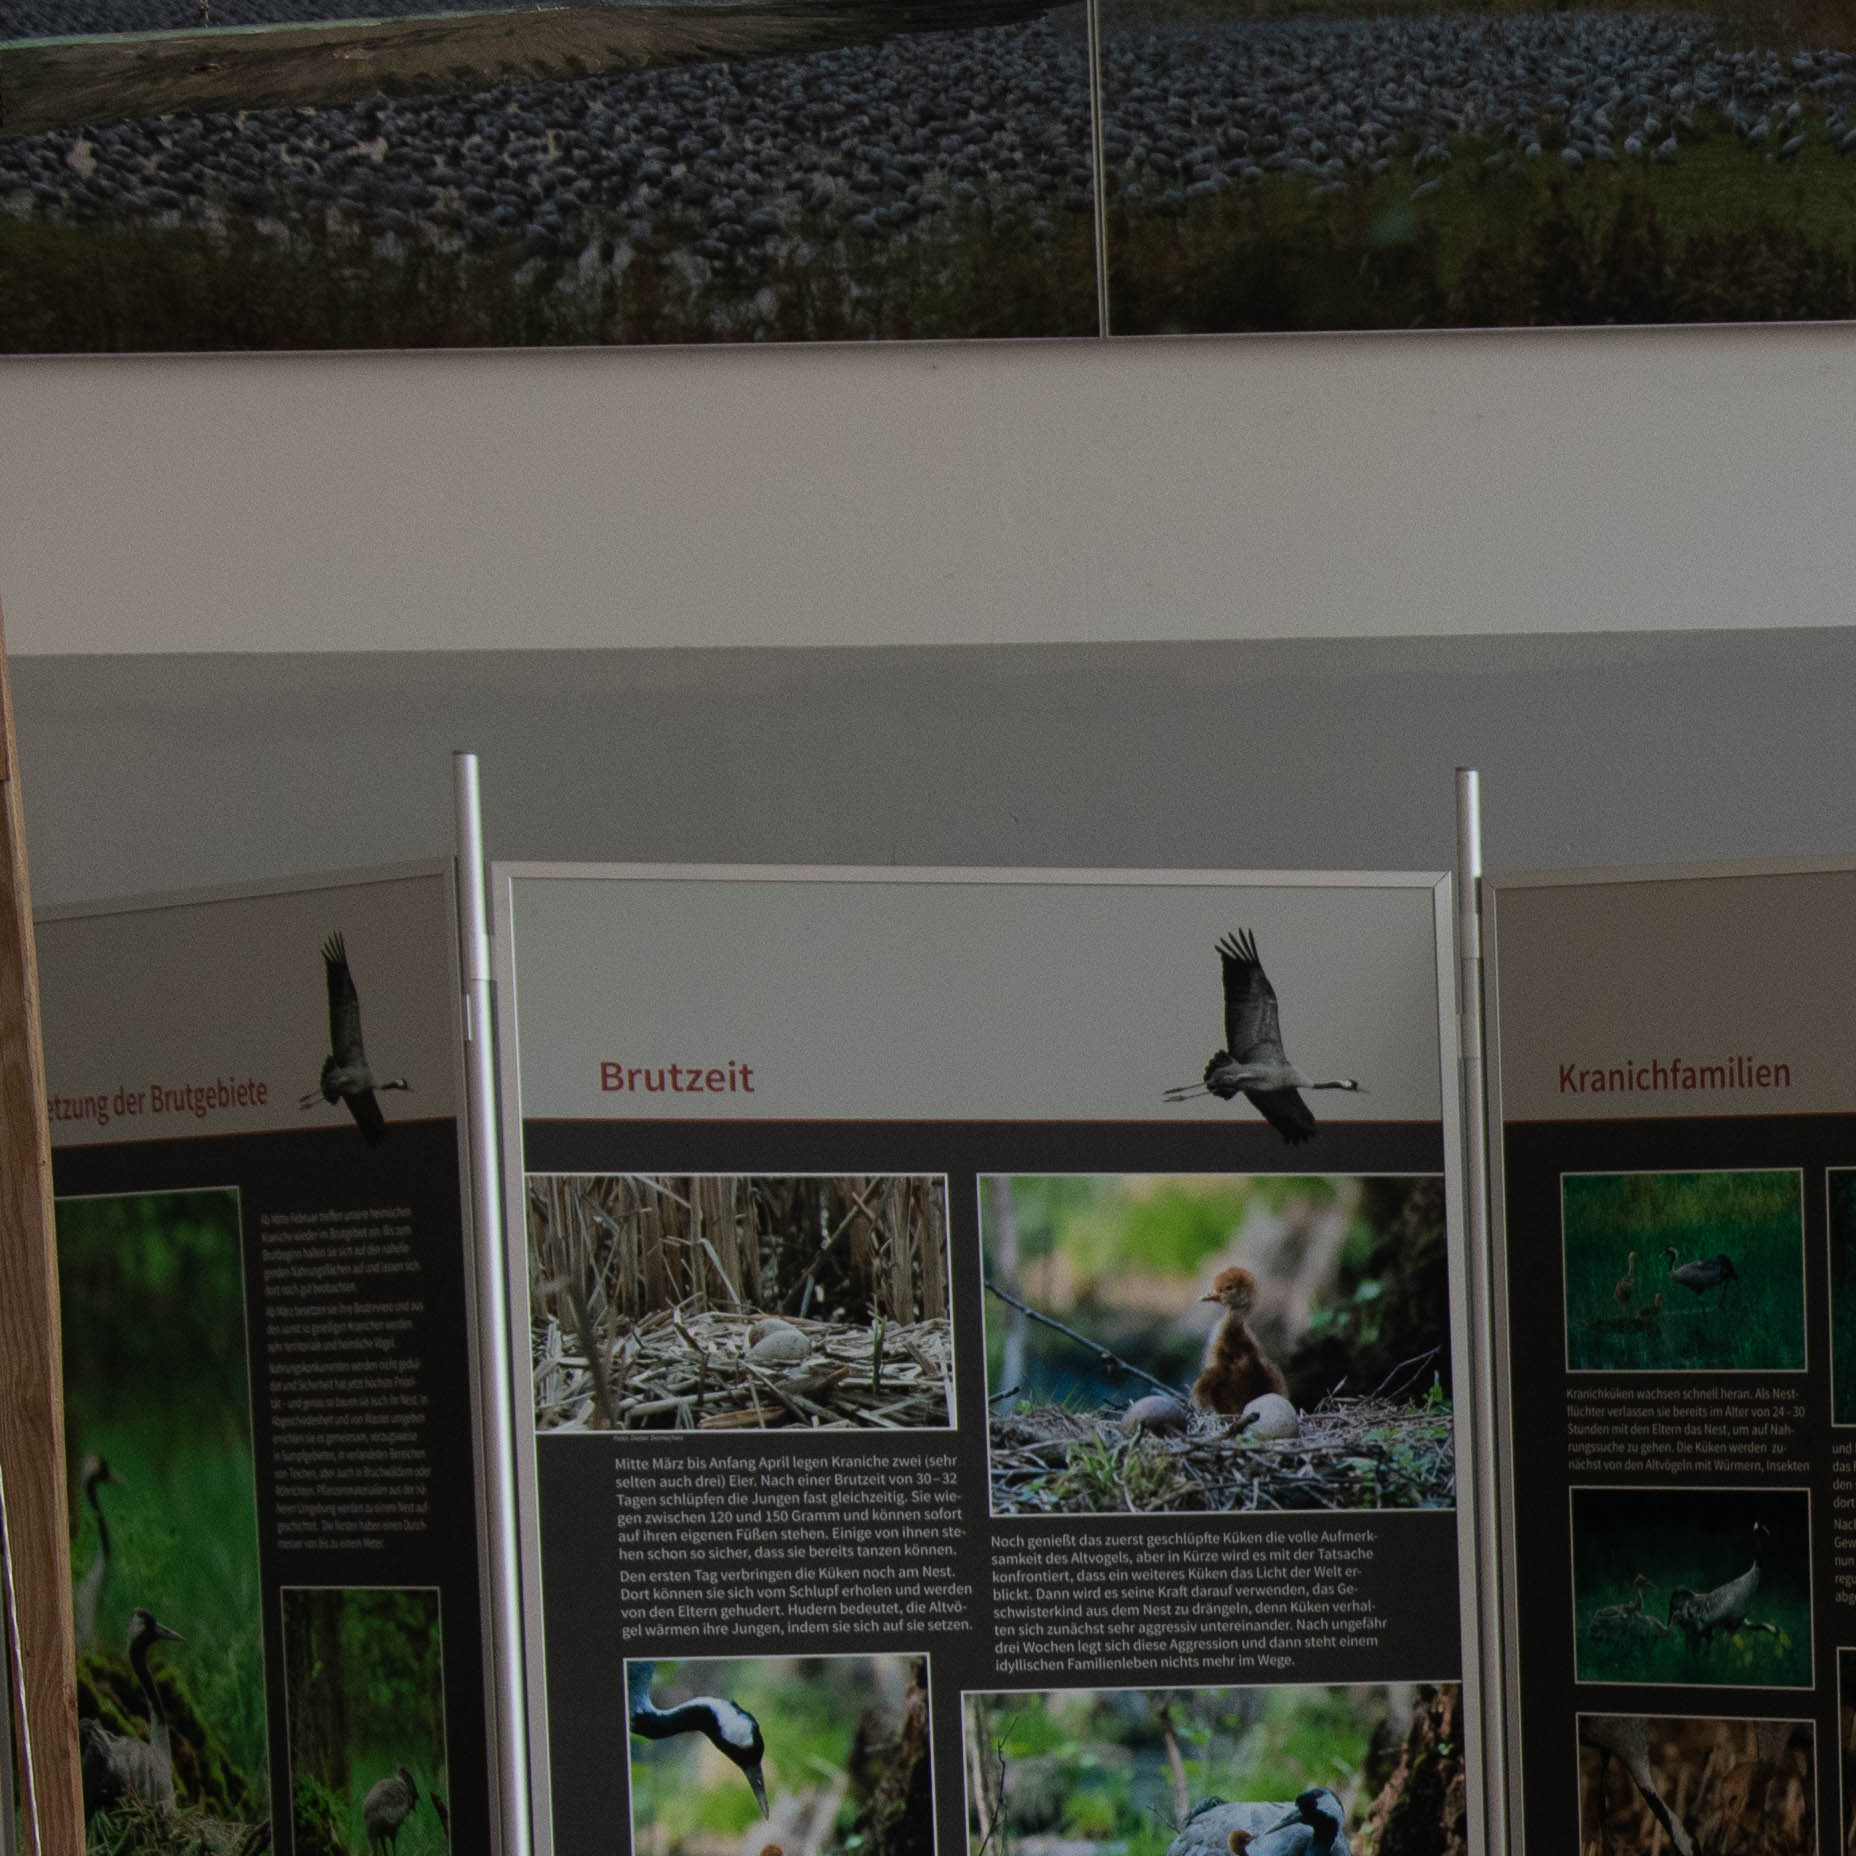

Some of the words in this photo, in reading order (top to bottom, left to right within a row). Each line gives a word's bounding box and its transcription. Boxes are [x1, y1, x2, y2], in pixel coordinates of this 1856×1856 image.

[600, 1061, 753, 1092] Brutzeit
[1559, 1056, 1790, 1092] Kranichfamilien
[113, 1085, 146, 1116] der
[151, 1076, 268, 1120] Brutgebiete
[614, 1457, 649, 1470] Mitte
[651, 1457, 684, 1470] März
[686, 1456, 707, 1469] bis
[708, 1455, 757, 1472] Anfang
[757, 1455, 789, 1471] April
[792, 1455, 828, 1471] legen
[831, 1454, 889, 1468] Kraniche
[891, 1457, 921, 1467] zwei
[924, 1453, 957, 1468] (sehr
[990, 1534, 1025, 1548] Noch
[1027, 1533, 1076, 1550] genießt
[1078, 1533, 1102, 1546] das
[1104, 1534, 1143, 1546] zuerst
[1146, 1531, 1220, 1548] geschlüpfte
[1222, 1531, 1263, 1544] Küken
[1265, 1531, 1285, 1543] die
[1287, 1530, 1318, 1543] volle
[1320, 1529, 1377, 1542] Aufmerk-
